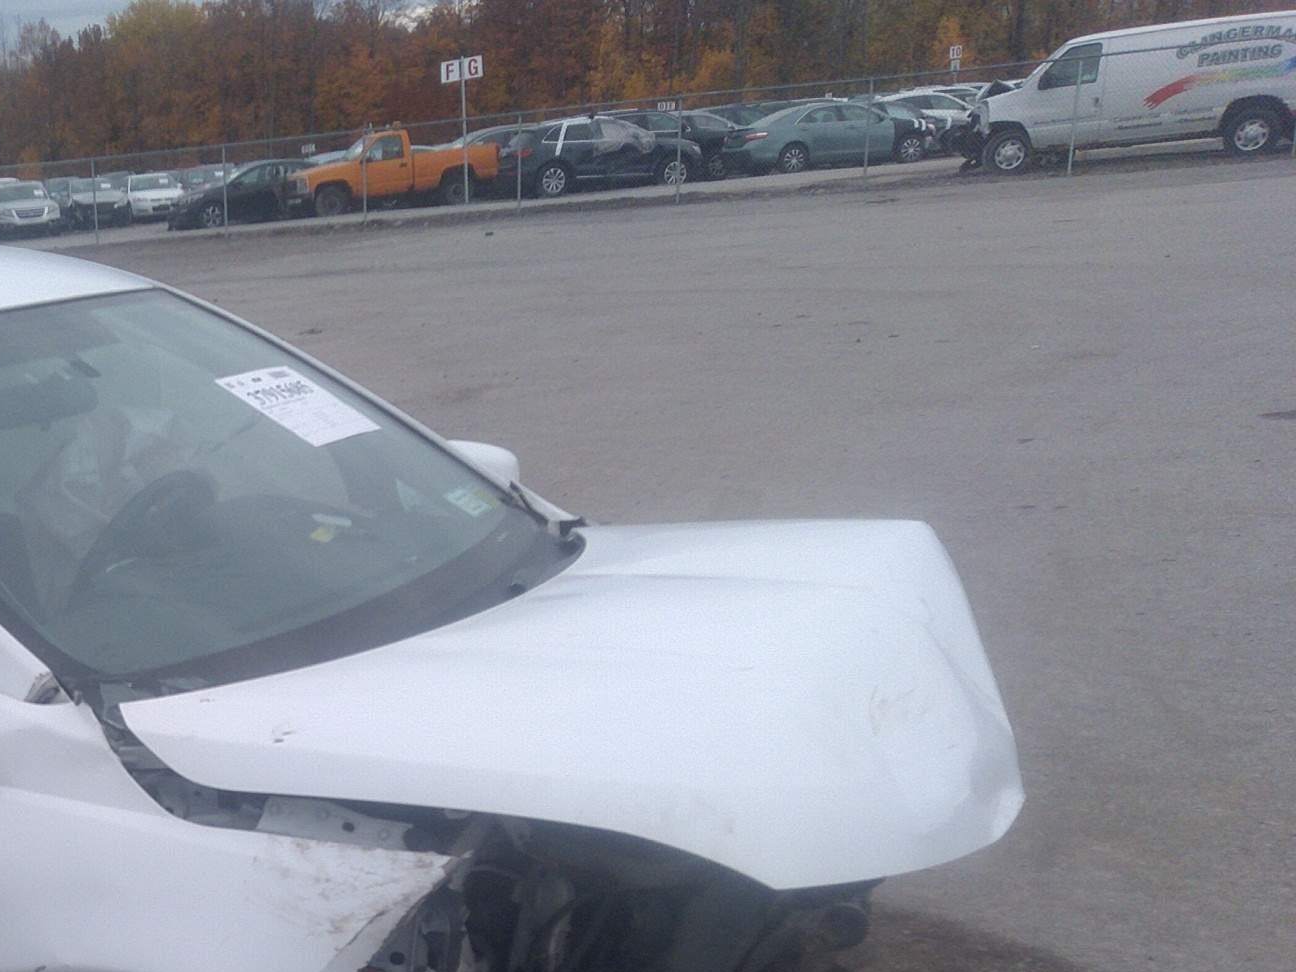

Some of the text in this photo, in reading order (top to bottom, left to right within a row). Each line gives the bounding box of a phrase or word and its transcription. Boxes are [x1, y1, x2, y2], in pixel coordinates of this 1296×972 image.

[1197, 43, 1283, 68] PAINTING
[446, 58, 478, 80] F G
